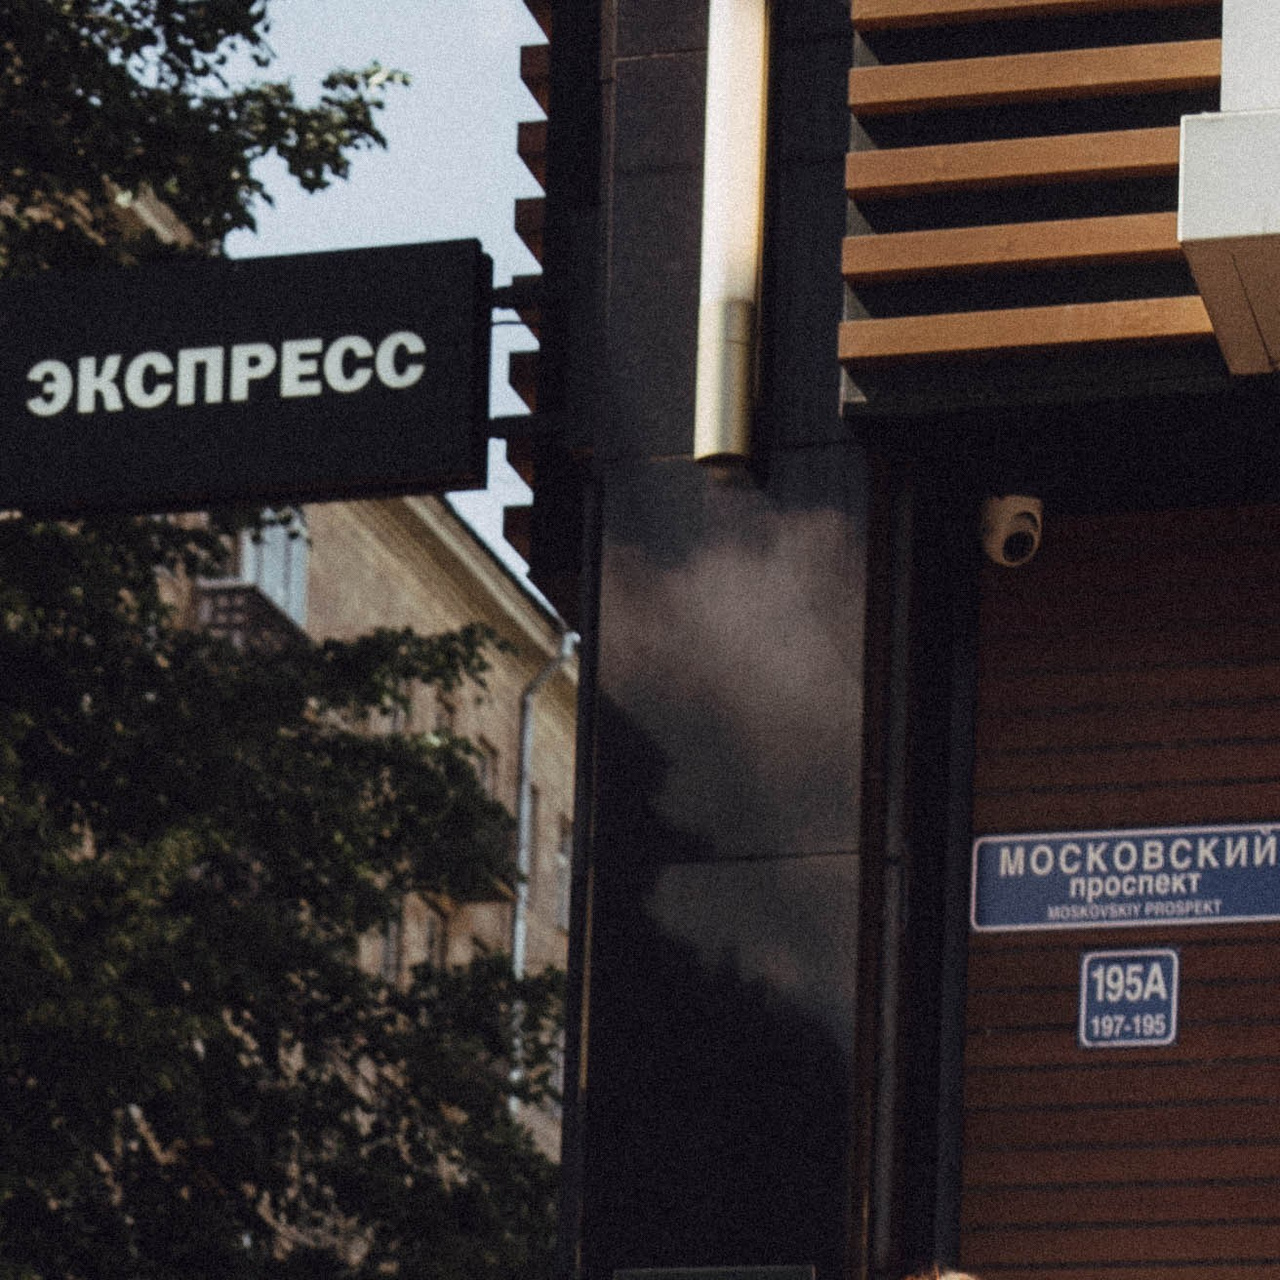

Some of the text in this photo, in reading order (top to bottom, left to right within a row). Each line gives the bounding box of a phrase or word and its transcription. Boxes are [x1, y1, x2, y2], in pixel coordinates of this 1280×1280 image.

[26, 331, 426, 417] ЭКСПРЕСС
[999, 828, 1278, 877] МОСКОВСКИЙ
[1069, 873, 1202, 902] проспект
[1144, 899, 1222, 916] PROSPEKT
[1091, 1014, 1166, 1038] 197-195
